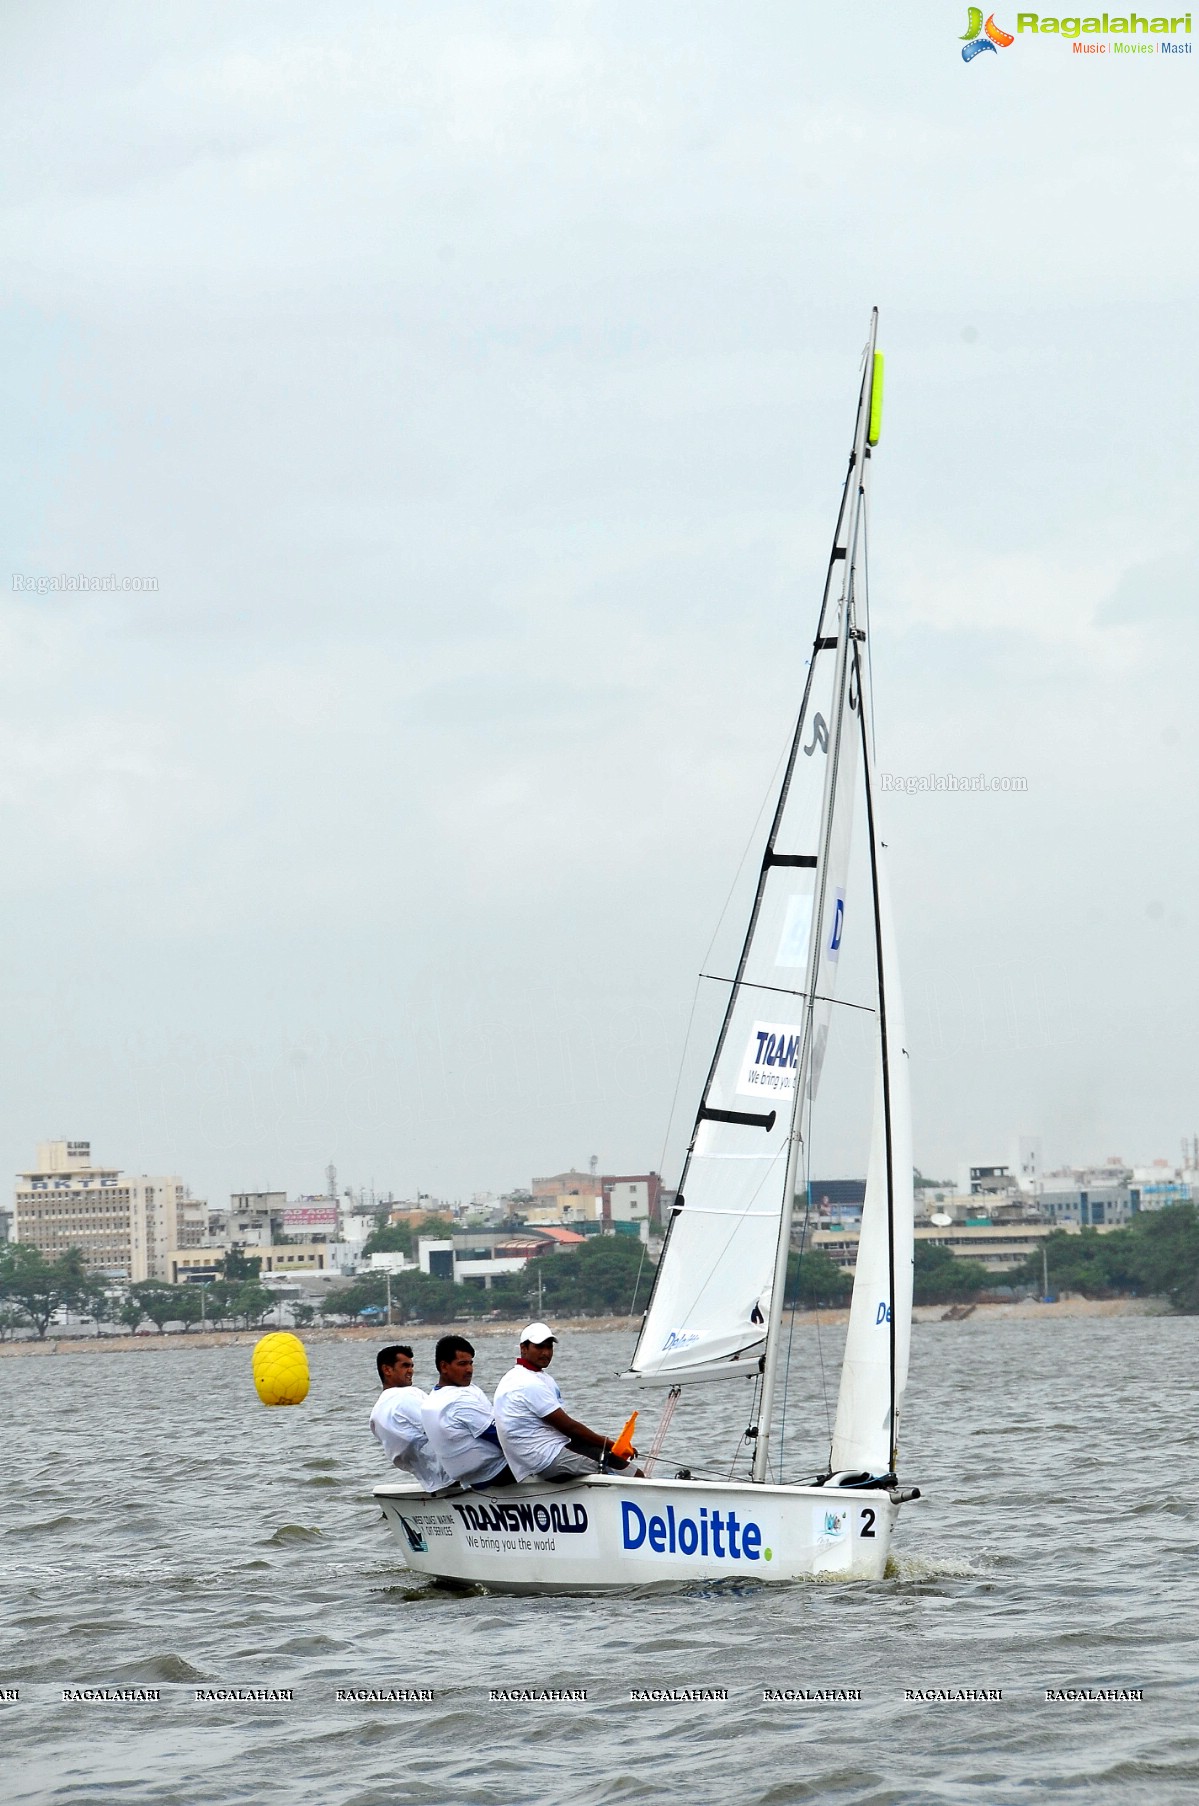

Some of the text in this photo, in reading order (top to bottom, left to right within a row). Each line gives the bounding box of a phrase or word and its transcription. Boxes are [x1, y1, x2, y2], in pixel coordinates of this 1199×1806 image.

[748, 1070, 760, 1084] We
[761, 1071, 780, 1090] bring
[452, 1503, 588, 1534] TRANSWORLD
[860, 1508, 876, 1538] 2
[466, 1535, 555, 1552] We bring you the world
